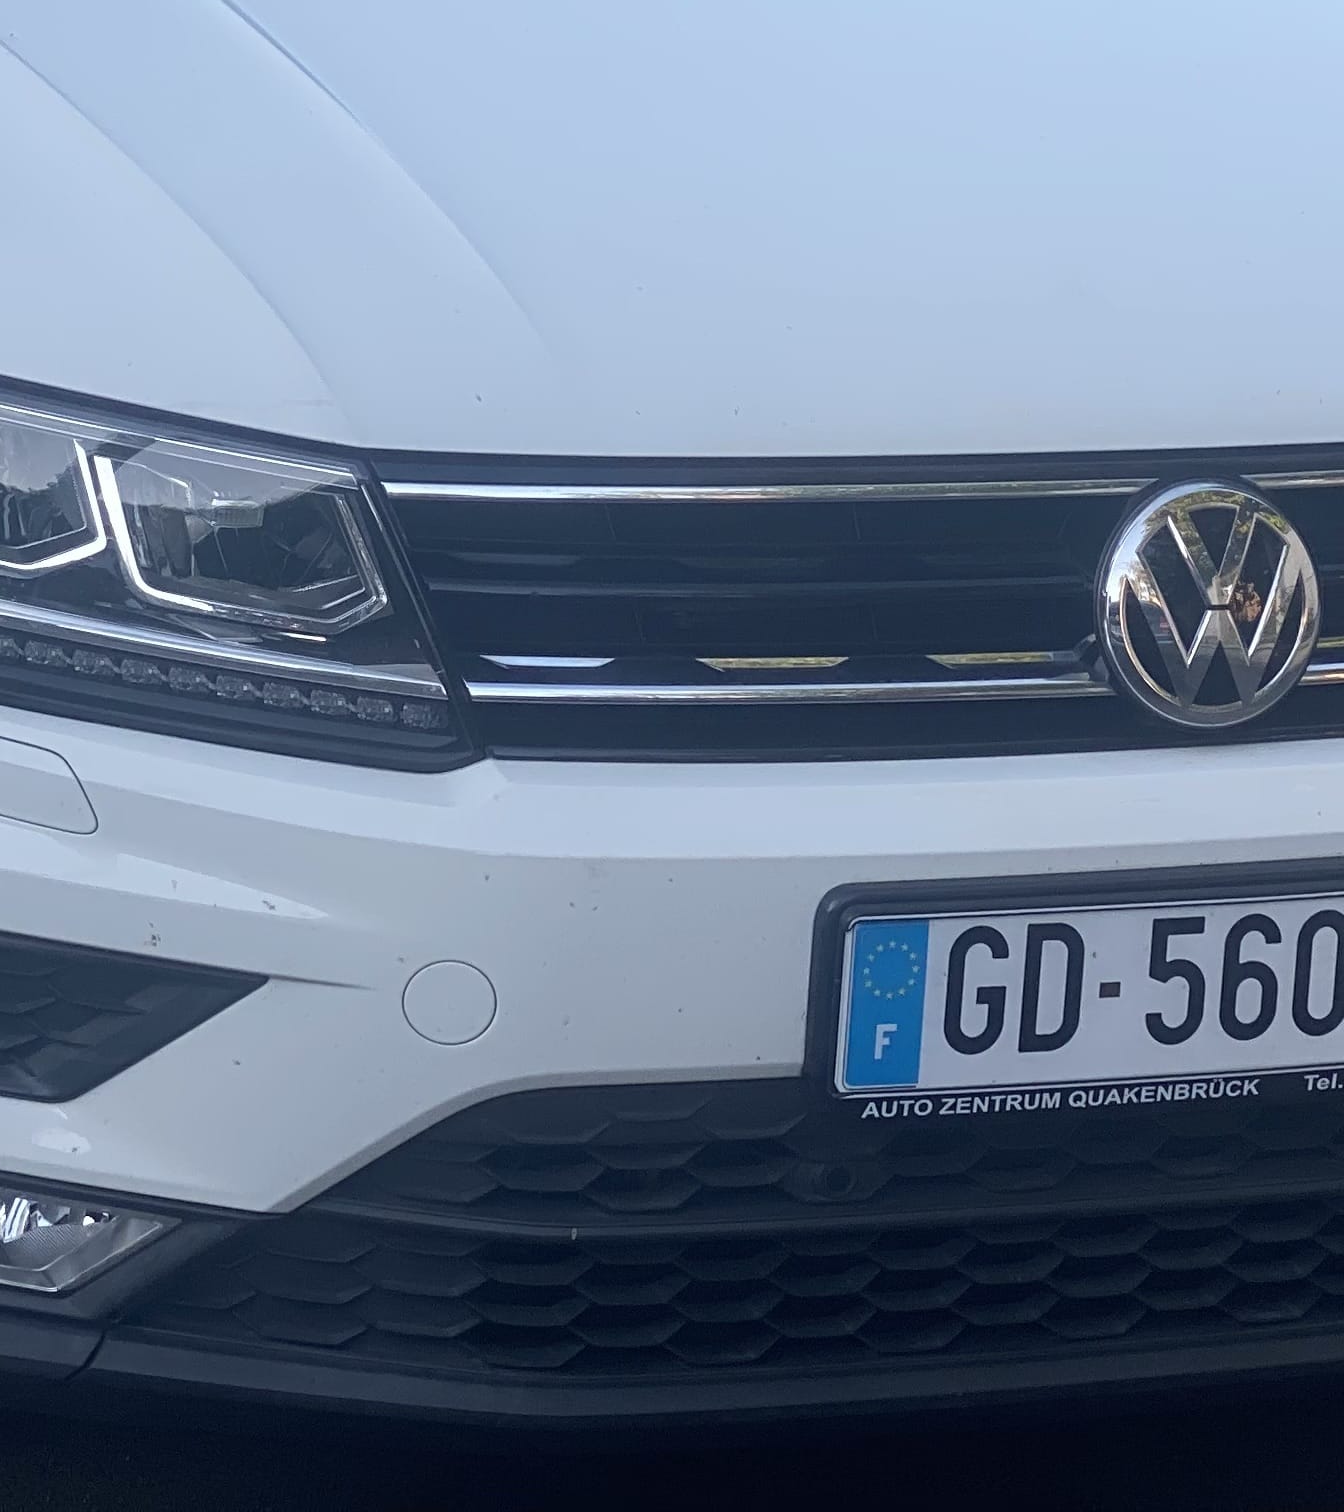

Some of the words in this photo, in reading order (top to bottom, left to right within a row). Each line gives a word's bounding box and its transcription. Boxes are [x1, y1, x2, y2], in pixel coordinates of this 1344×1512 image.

[873, 1023, 898, 1061] F
[861, 1098, 933, 1120] AUTO
[938, 1092, 1061, 1116] ZENTRUM
[1068, 1078, 1261, 1108] QUAKENBRÜCK
[1304, 1073, 1344, 1091] Tel.
